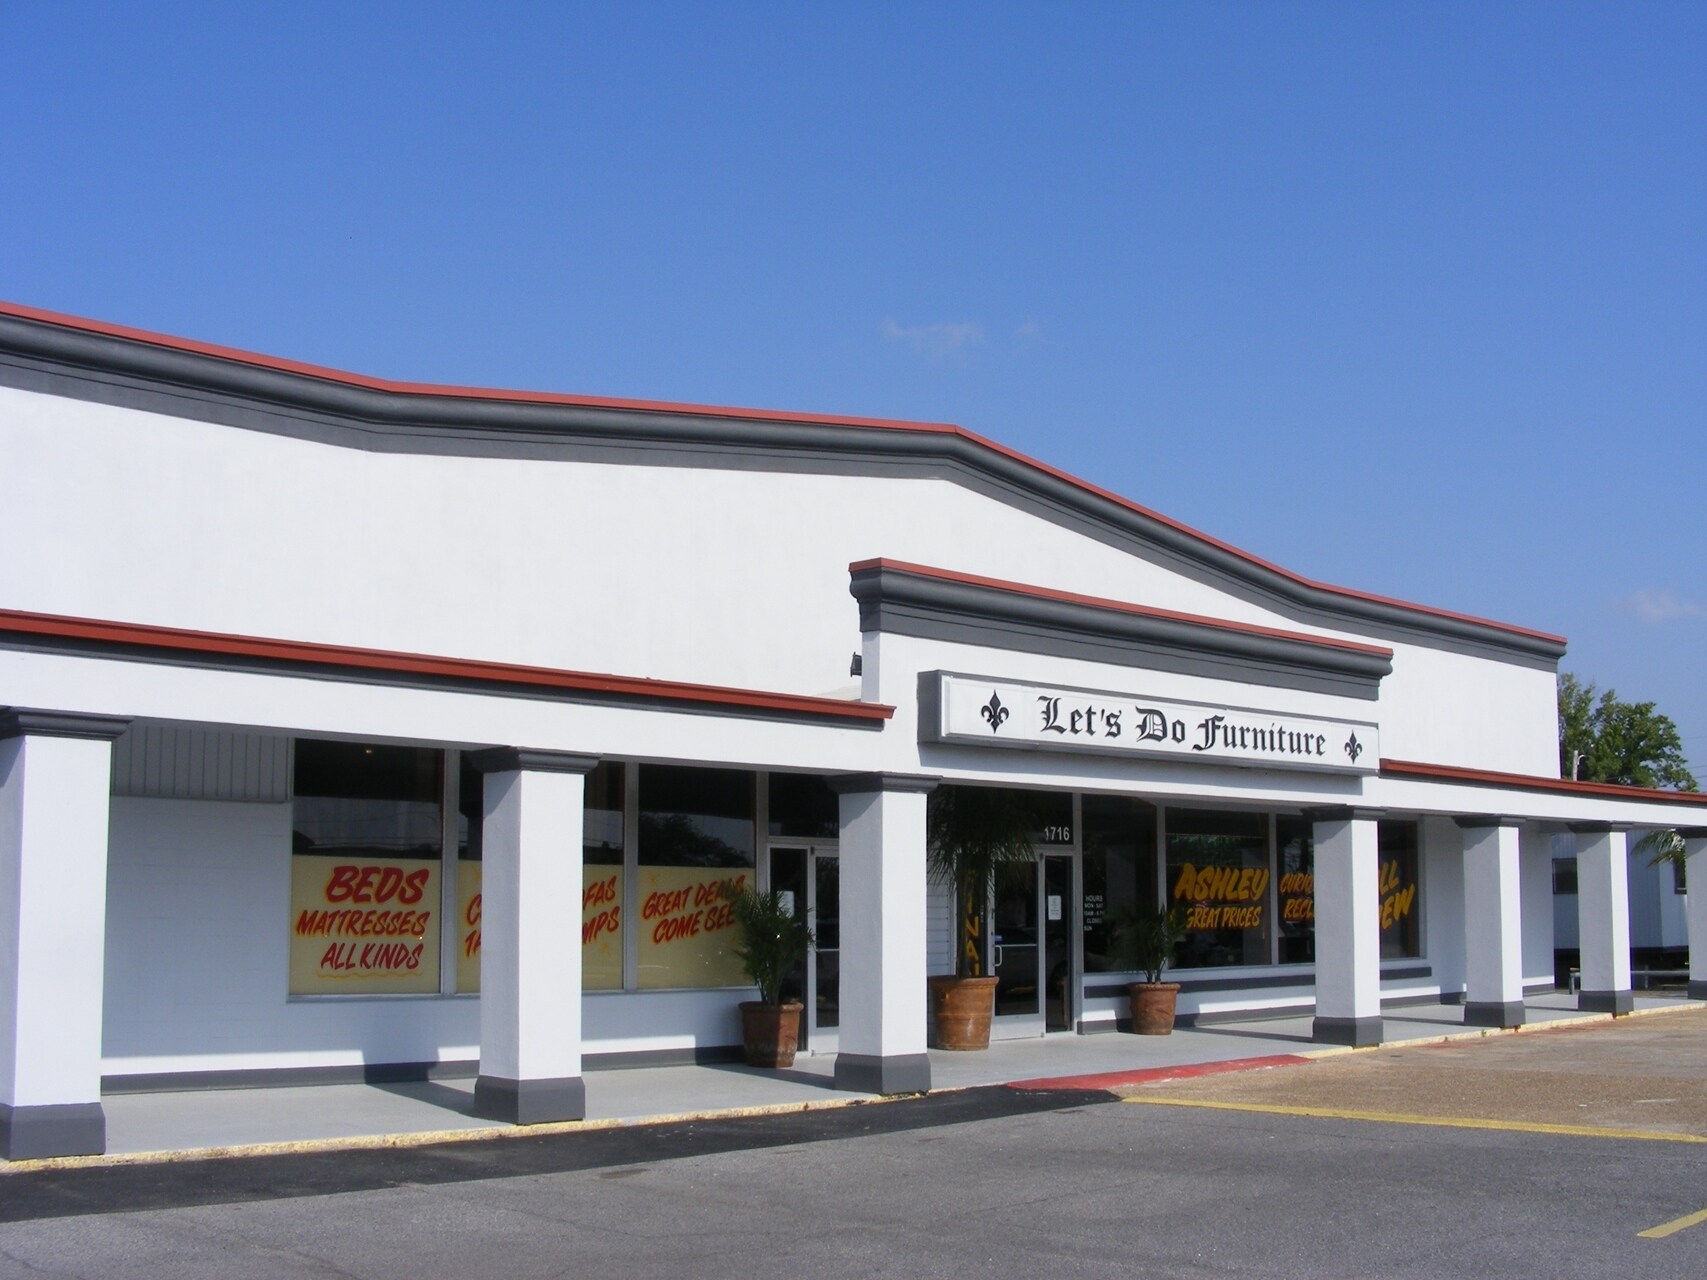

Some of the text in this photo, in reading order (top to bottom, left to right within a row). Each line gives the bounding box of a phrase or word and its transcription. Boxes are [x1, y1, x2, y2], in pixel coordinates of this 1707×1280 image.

[1036, 695, 1327, 757] Let's Do Furniture
[1044, 826, 1070, 841] 1716
[325, 865, 430, 905] BEDS
[1173, 863, 1270, 901] ASHLEY
[641, 886, 693, 919] GREAT
[1185, 905, 1222, 929] GREAT
[1221, 904, 1263, 929] PRICES
[296, 909, 431, 936] MATTRESSES
[653, 903, 736, 945] COME SEE
[320, 942, 425, 971] ALL KINDS
